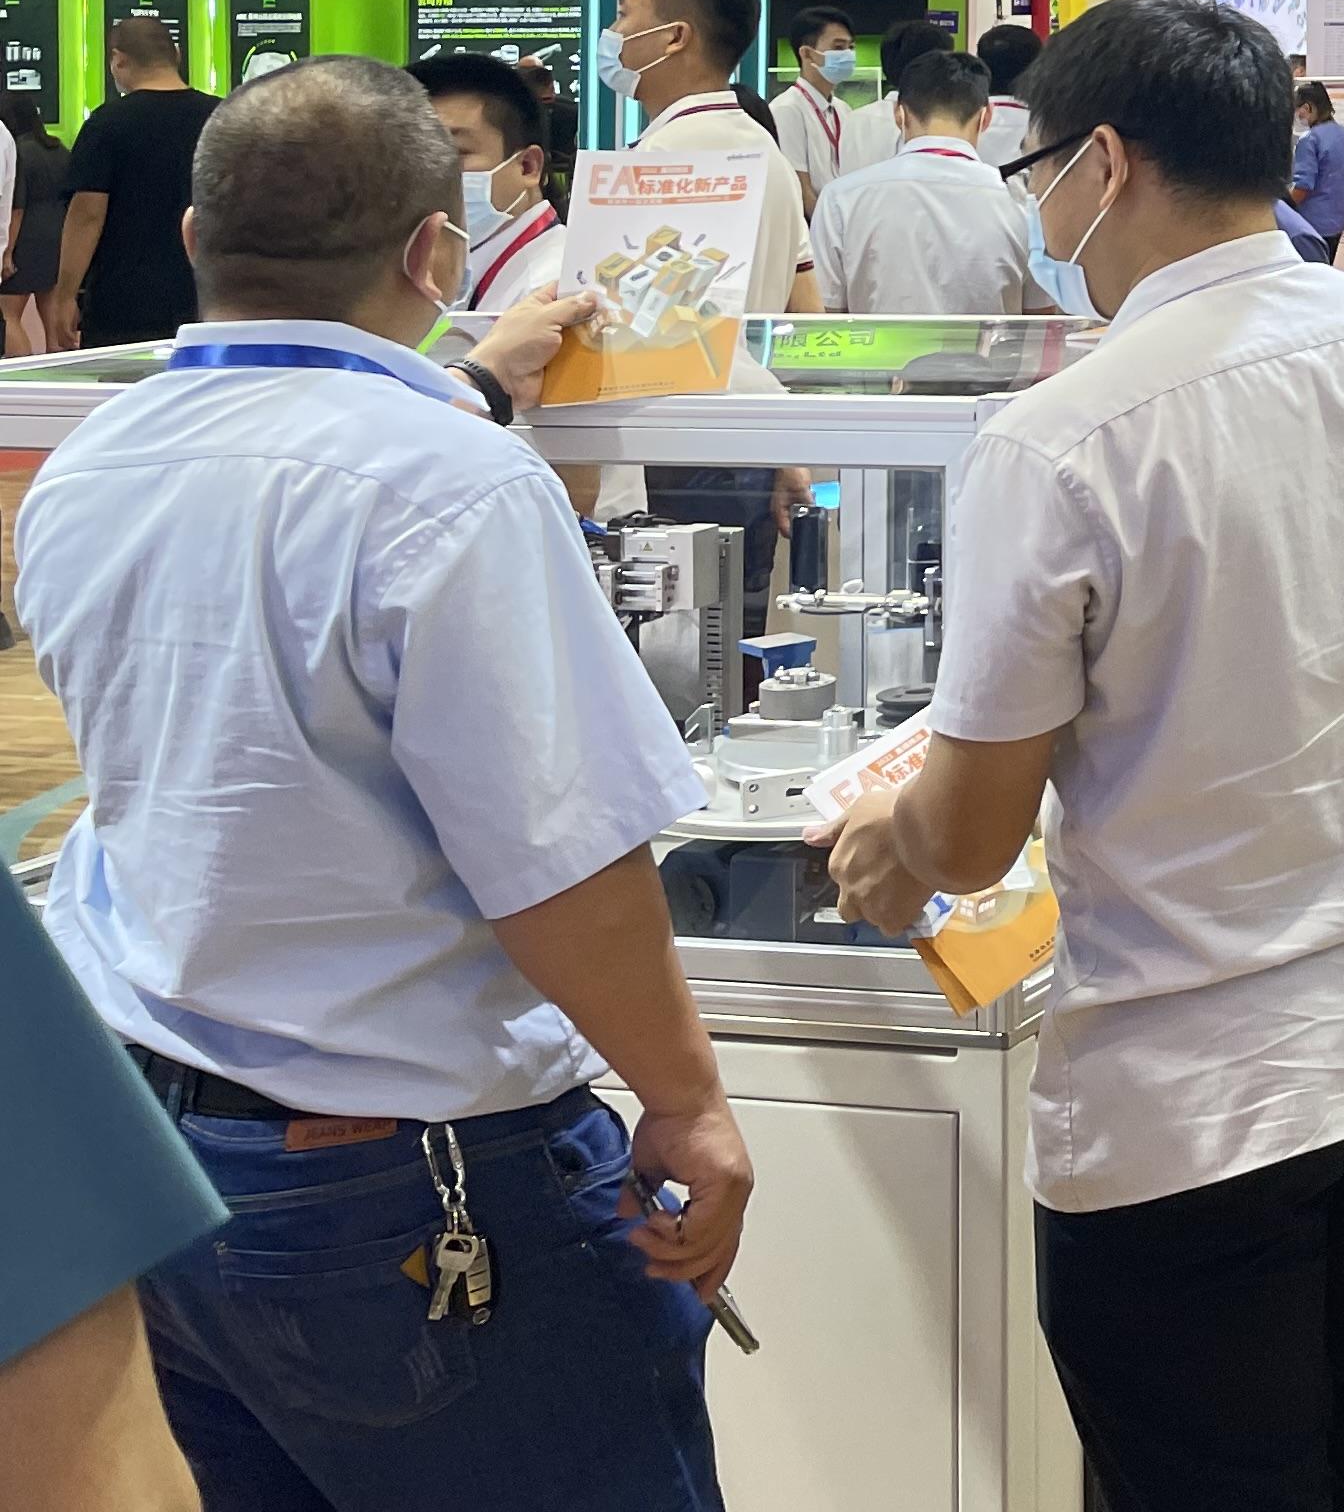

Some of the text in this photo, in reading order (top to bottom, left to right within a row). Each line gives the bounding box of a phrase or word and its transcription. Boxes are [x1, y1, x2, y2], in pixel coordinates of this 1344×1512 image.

[639, 175, 748, 196] 标准化新产品
